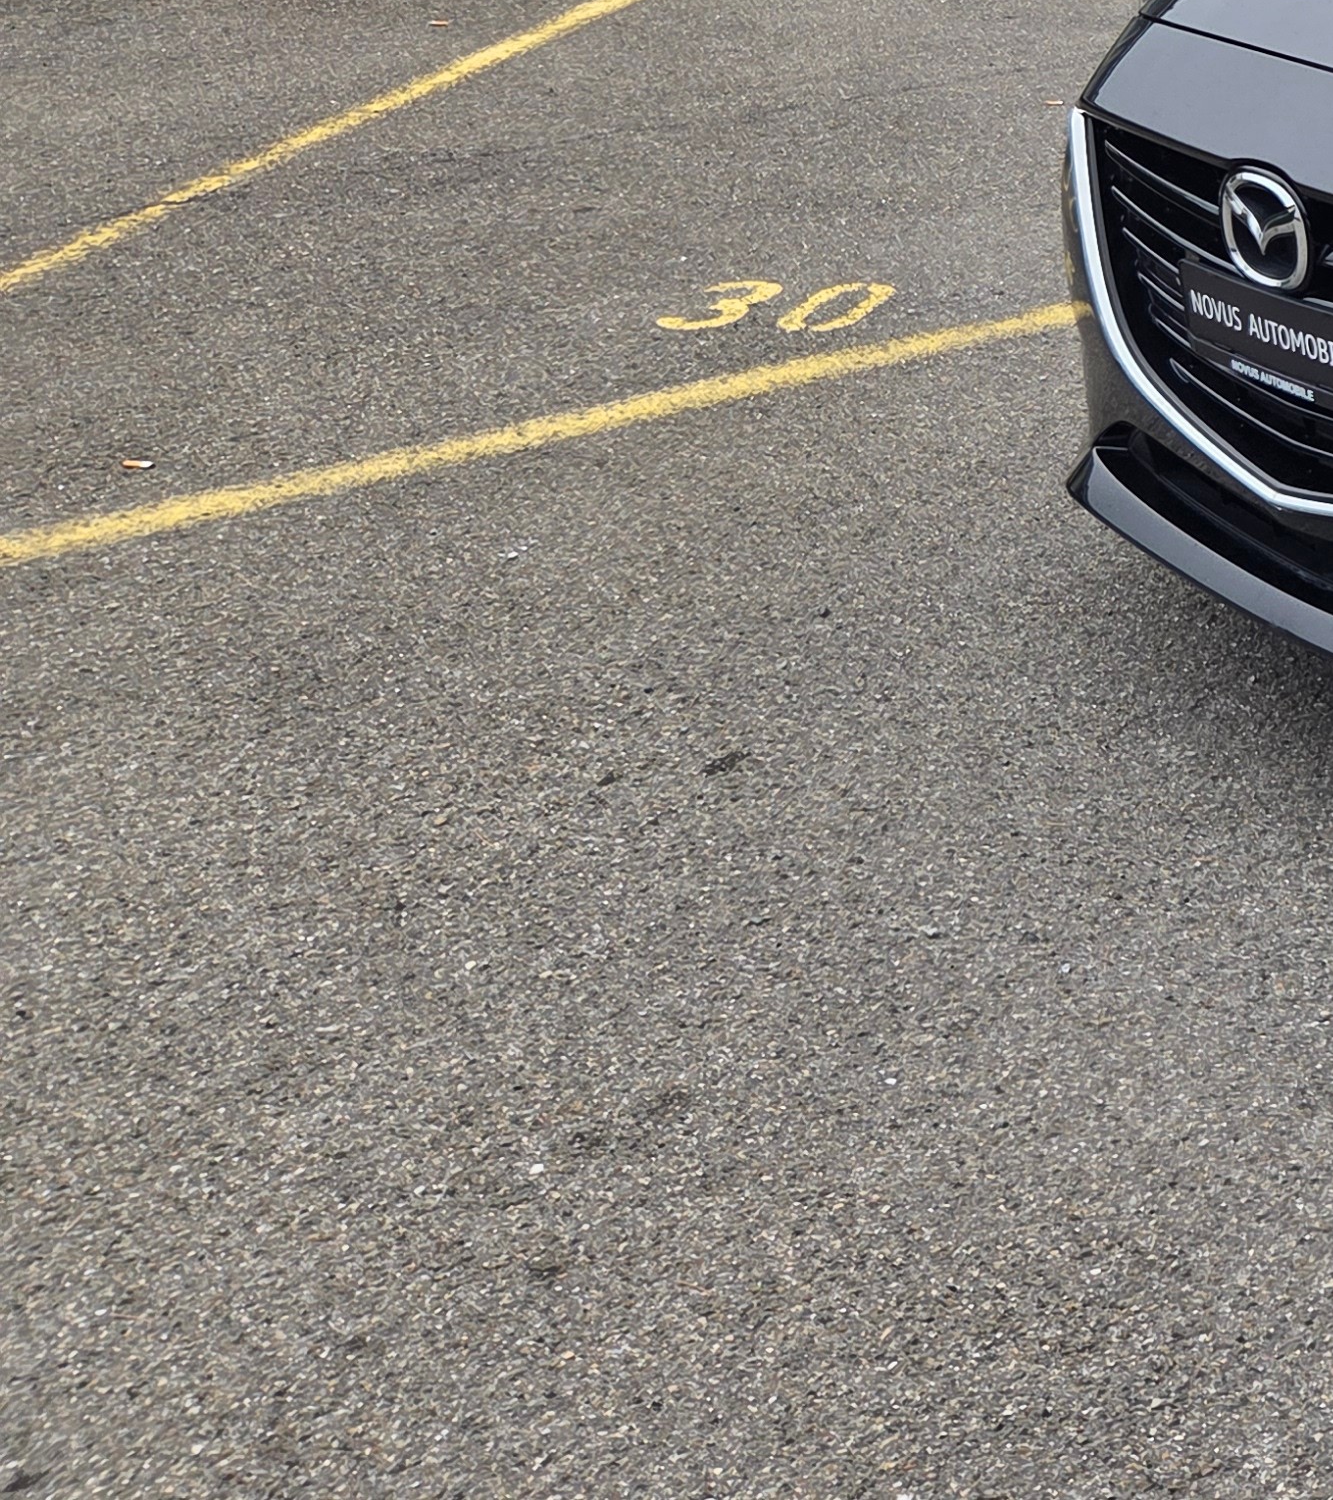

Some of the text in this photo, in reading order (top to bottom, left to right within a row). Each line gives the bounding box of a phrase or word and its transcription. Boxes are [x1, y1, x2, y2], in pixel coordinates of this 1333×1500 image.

[656, 280, 896, 331] 30
[1190, 289, 1242, 331] NOVUS
[1230, 359, 1315, 402] NOVUS AUTOMOBILE
